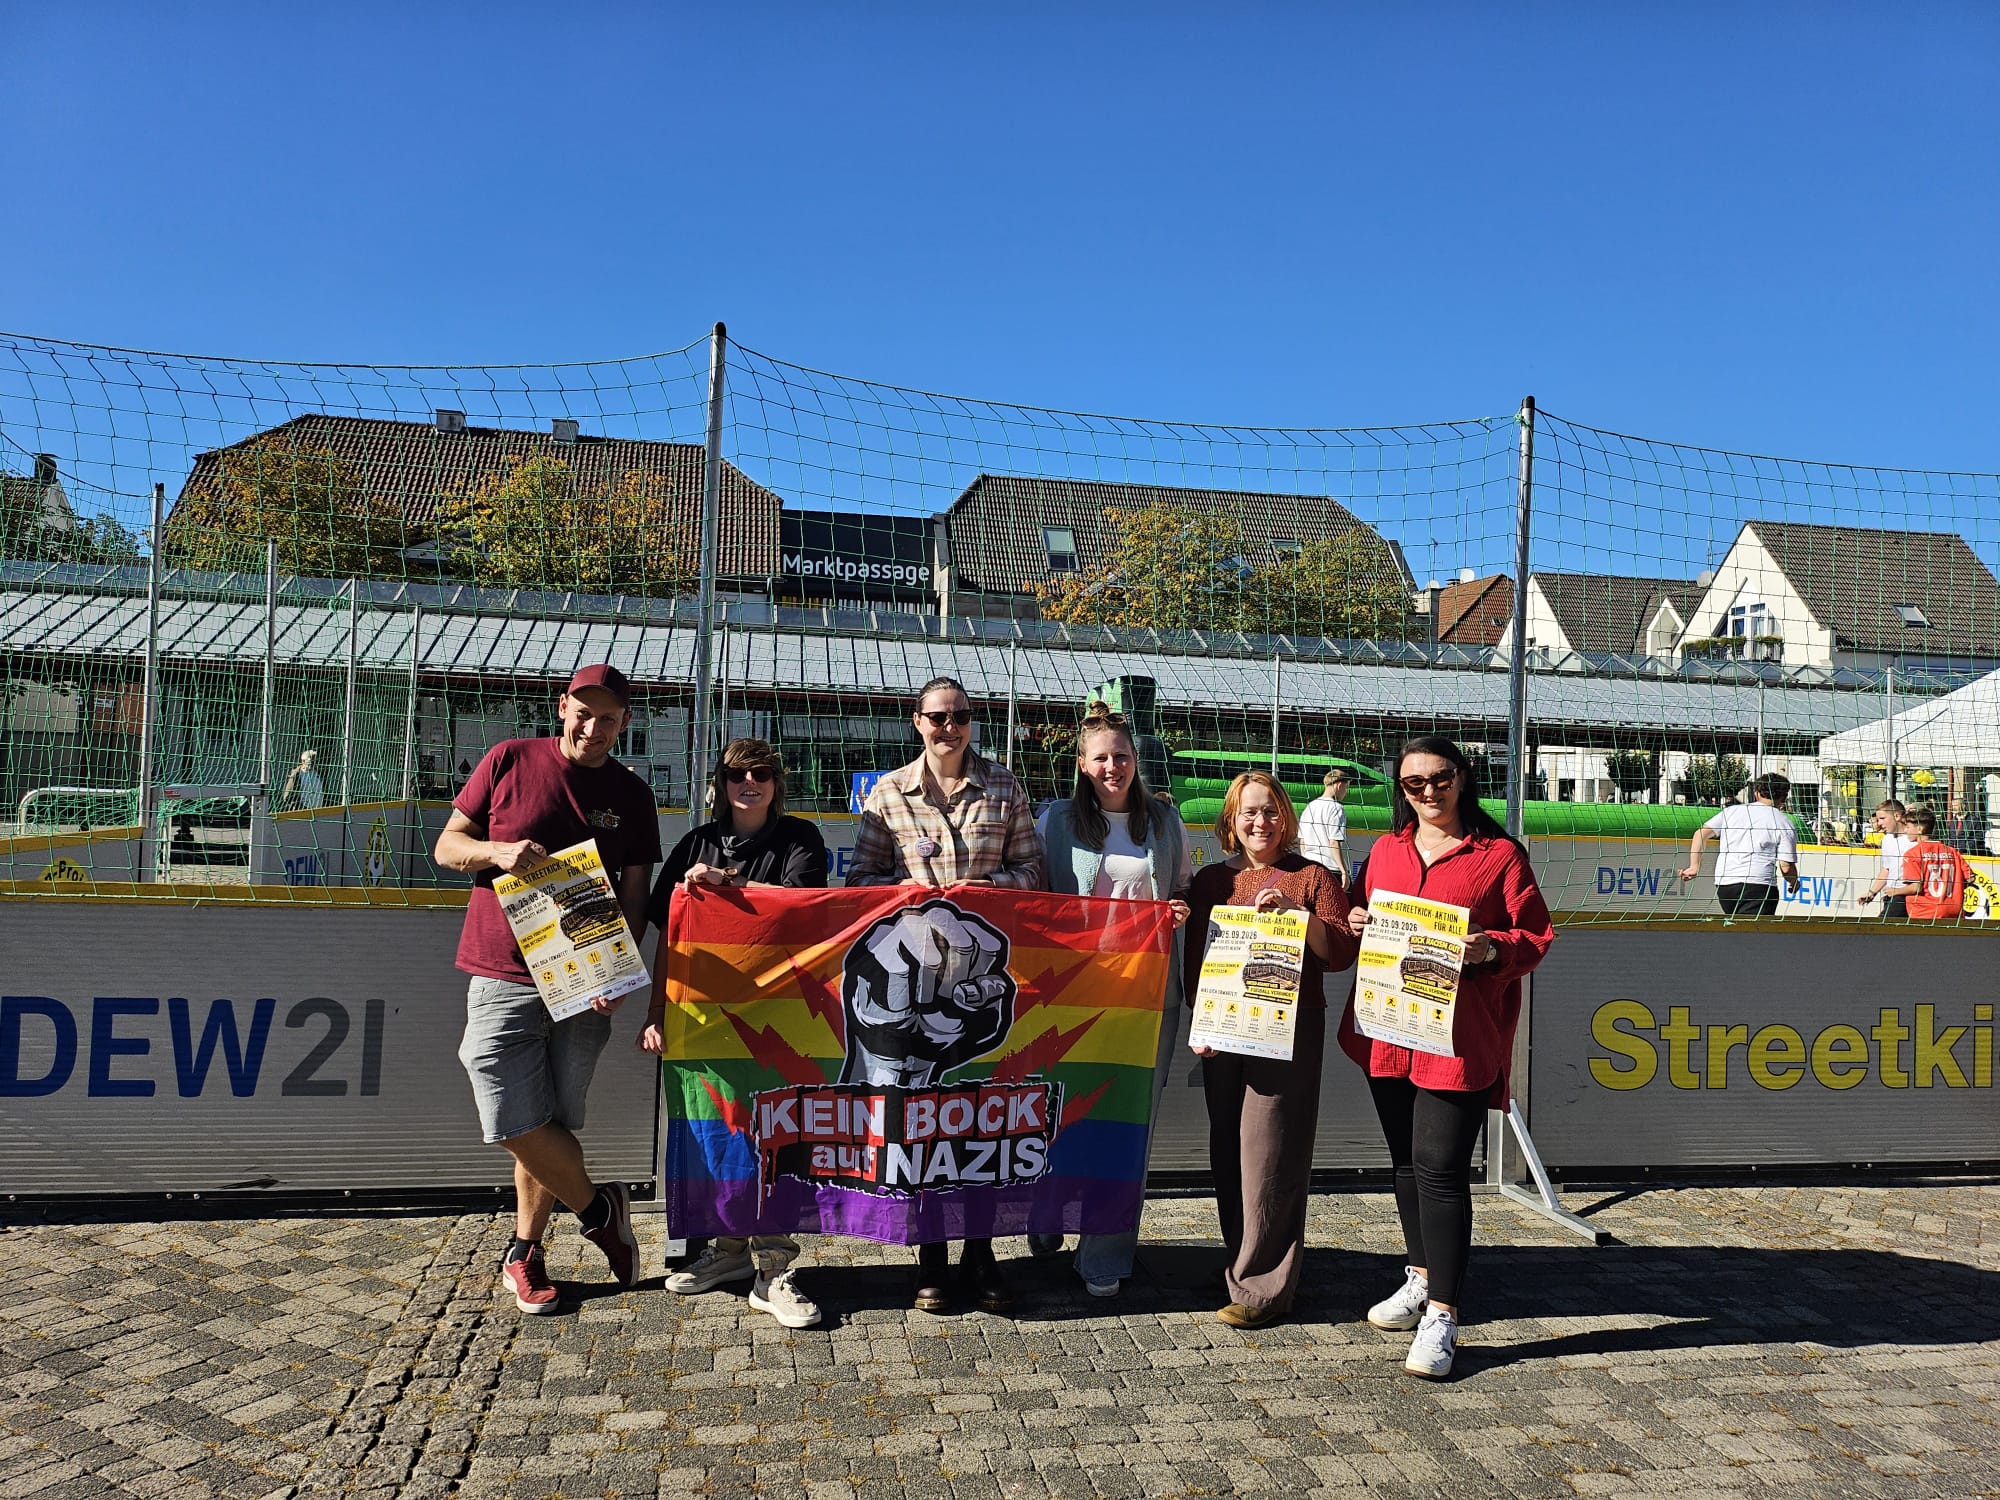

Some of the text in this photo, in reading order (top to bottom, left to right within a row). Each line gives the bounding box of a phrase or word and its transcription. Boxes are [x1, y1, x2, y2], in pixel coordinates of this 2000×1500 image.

[782, 554, 930, 586] Marktpassage
[499, 851, 587, 895] OFFENE STREETKICK-AKTION
[581, 859, 597, 873] ALLE
[1597, 867, 1685, 896] DEW21
[1970, 872, 2000, 906] rojekt
[1395, 902, 1459, 923] STREETKICK-AKTION
[1434, 920, 1463, 935] FÜR ALLE
[1273, 927, 1301, 938] FÜR ALLE
[0, 996, 385, 1097] DEW21
[760, 1091, 1046, 1140] KEIN BOCK
[812, 1137, 1047, 1185] auf NAZIS
